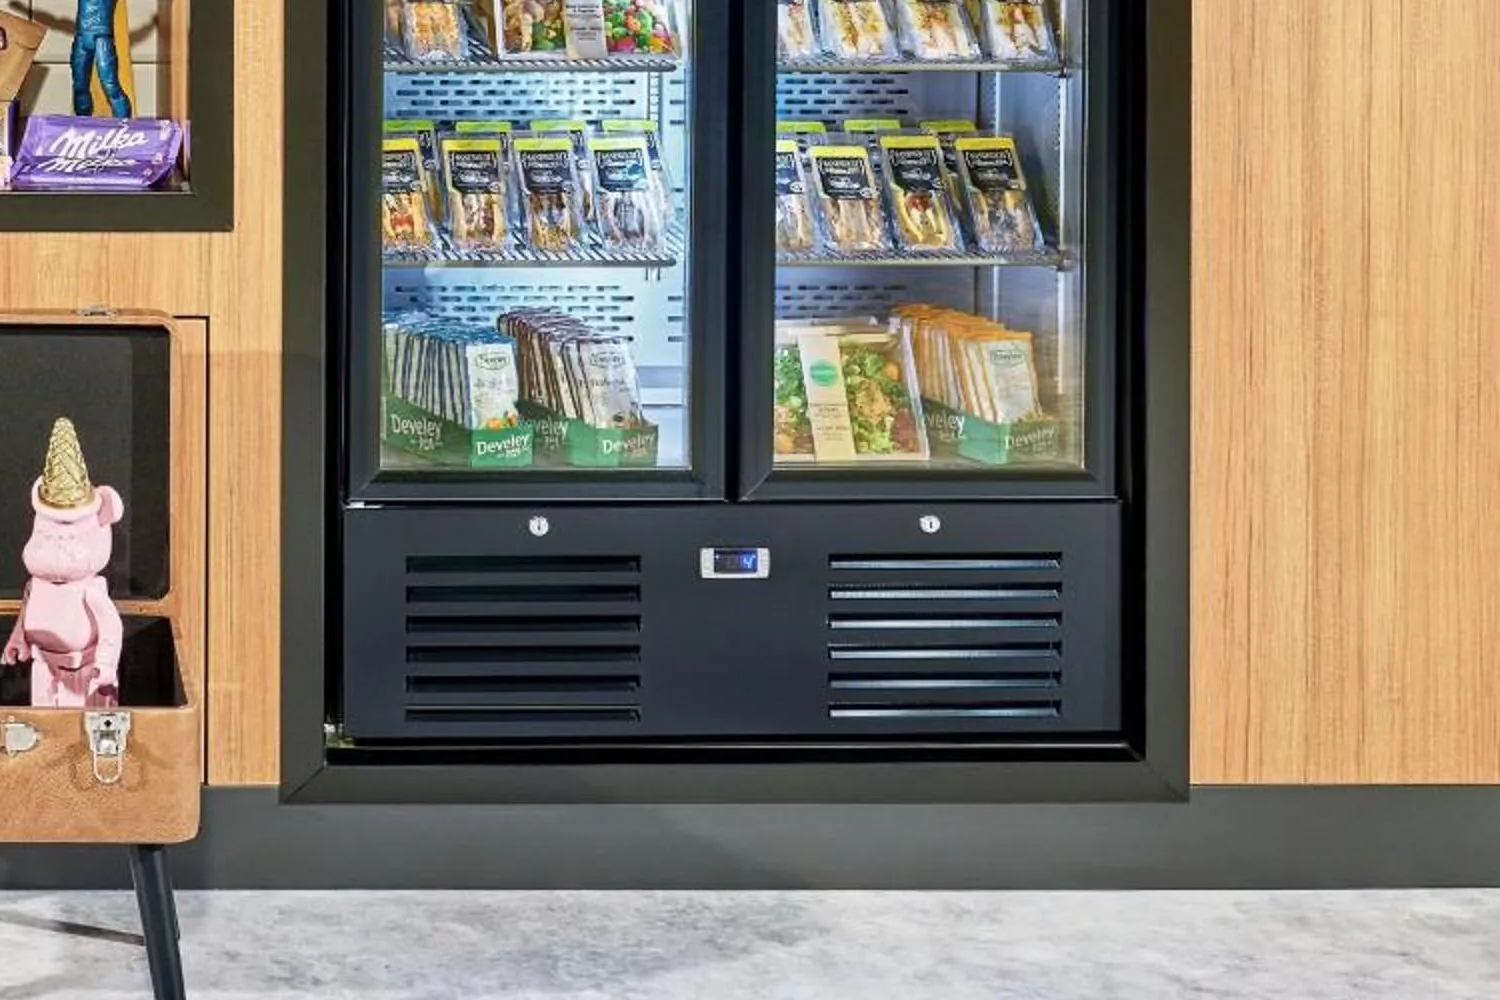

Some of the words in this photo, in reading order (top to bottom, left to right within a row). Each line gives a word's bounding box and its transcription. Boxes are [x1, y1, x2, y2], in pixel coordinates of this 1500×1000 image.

[50, 120, 149, 160] Milka
[391, 414, 442, 441] Develey
[477, 433, 531, 456] Develey
